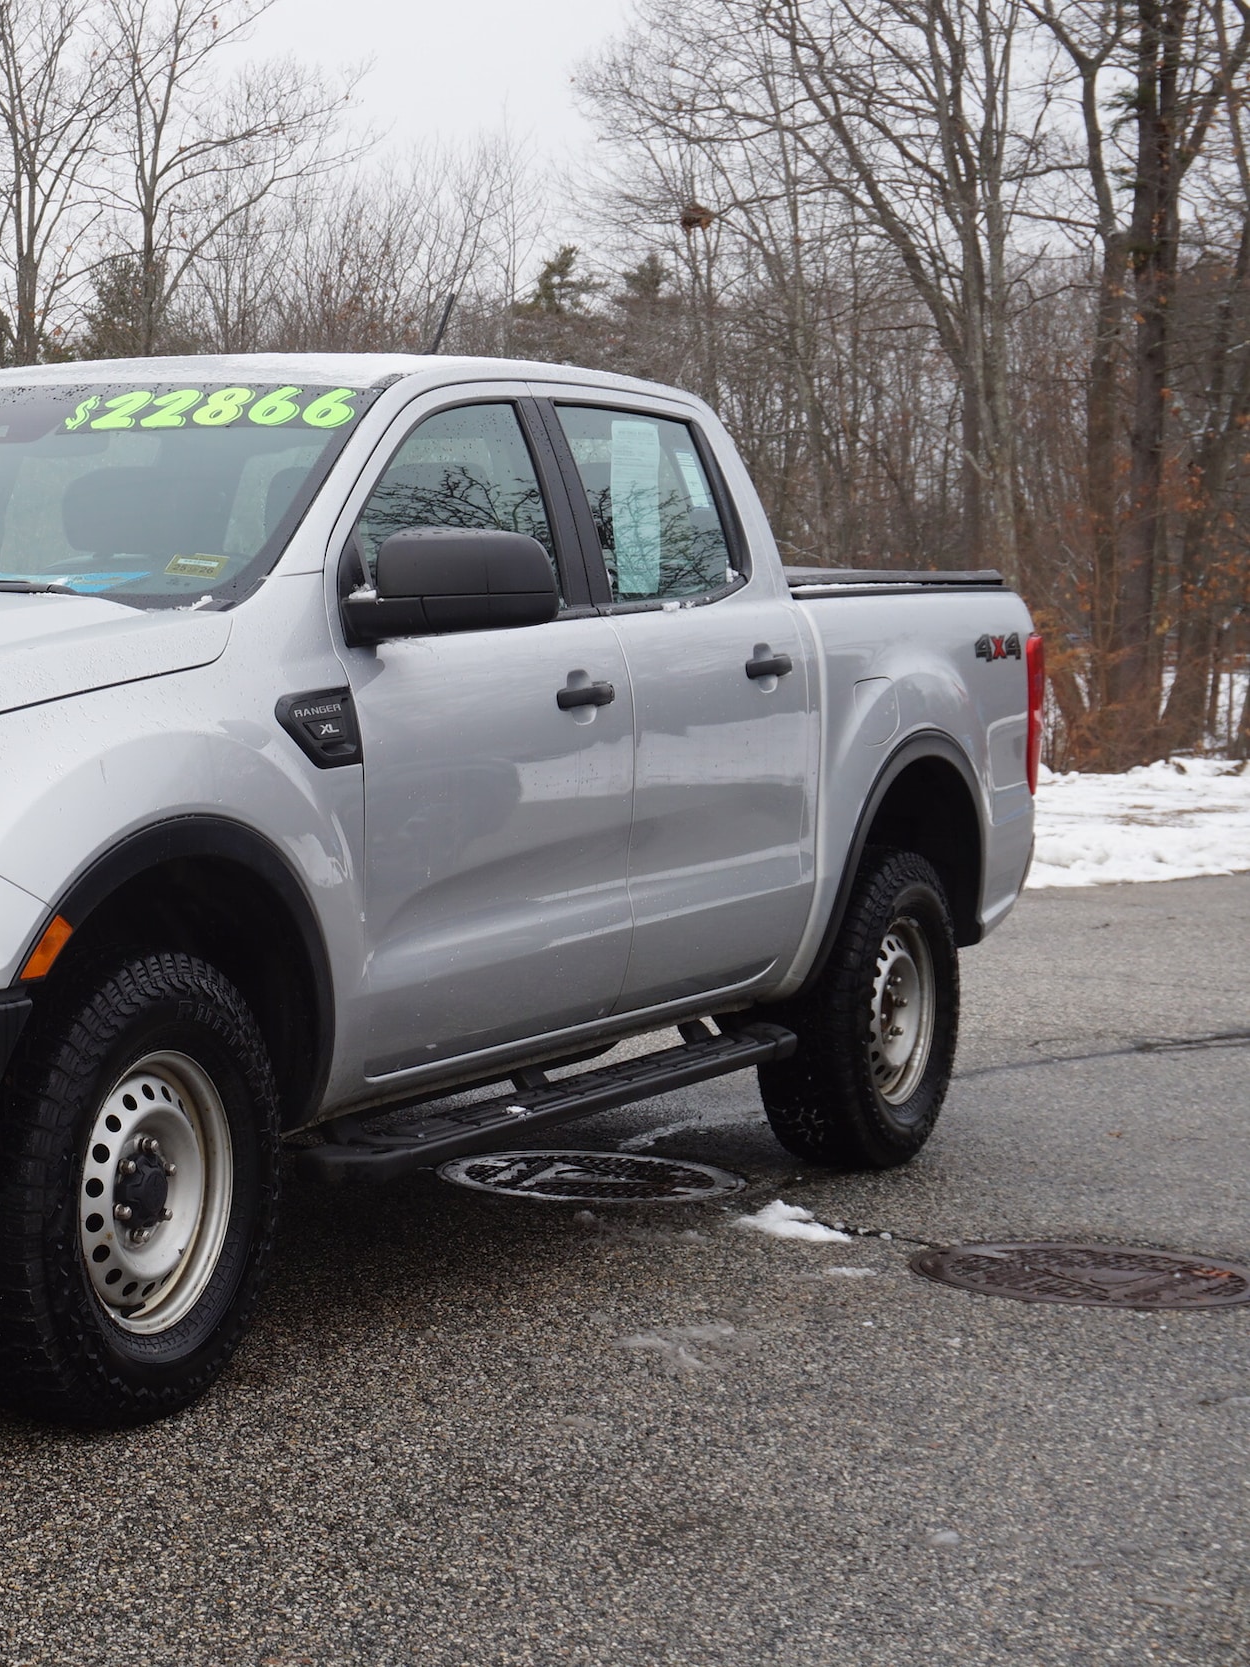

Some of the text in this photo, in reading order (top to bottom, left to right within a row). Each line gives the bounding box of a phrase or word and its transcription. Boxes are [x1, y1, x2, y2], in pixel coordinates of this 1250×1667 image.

[64, 386, 358, 430] $22866
[293, 703, 342, 718] RANGER
[319, 723, 340, 735] XL
